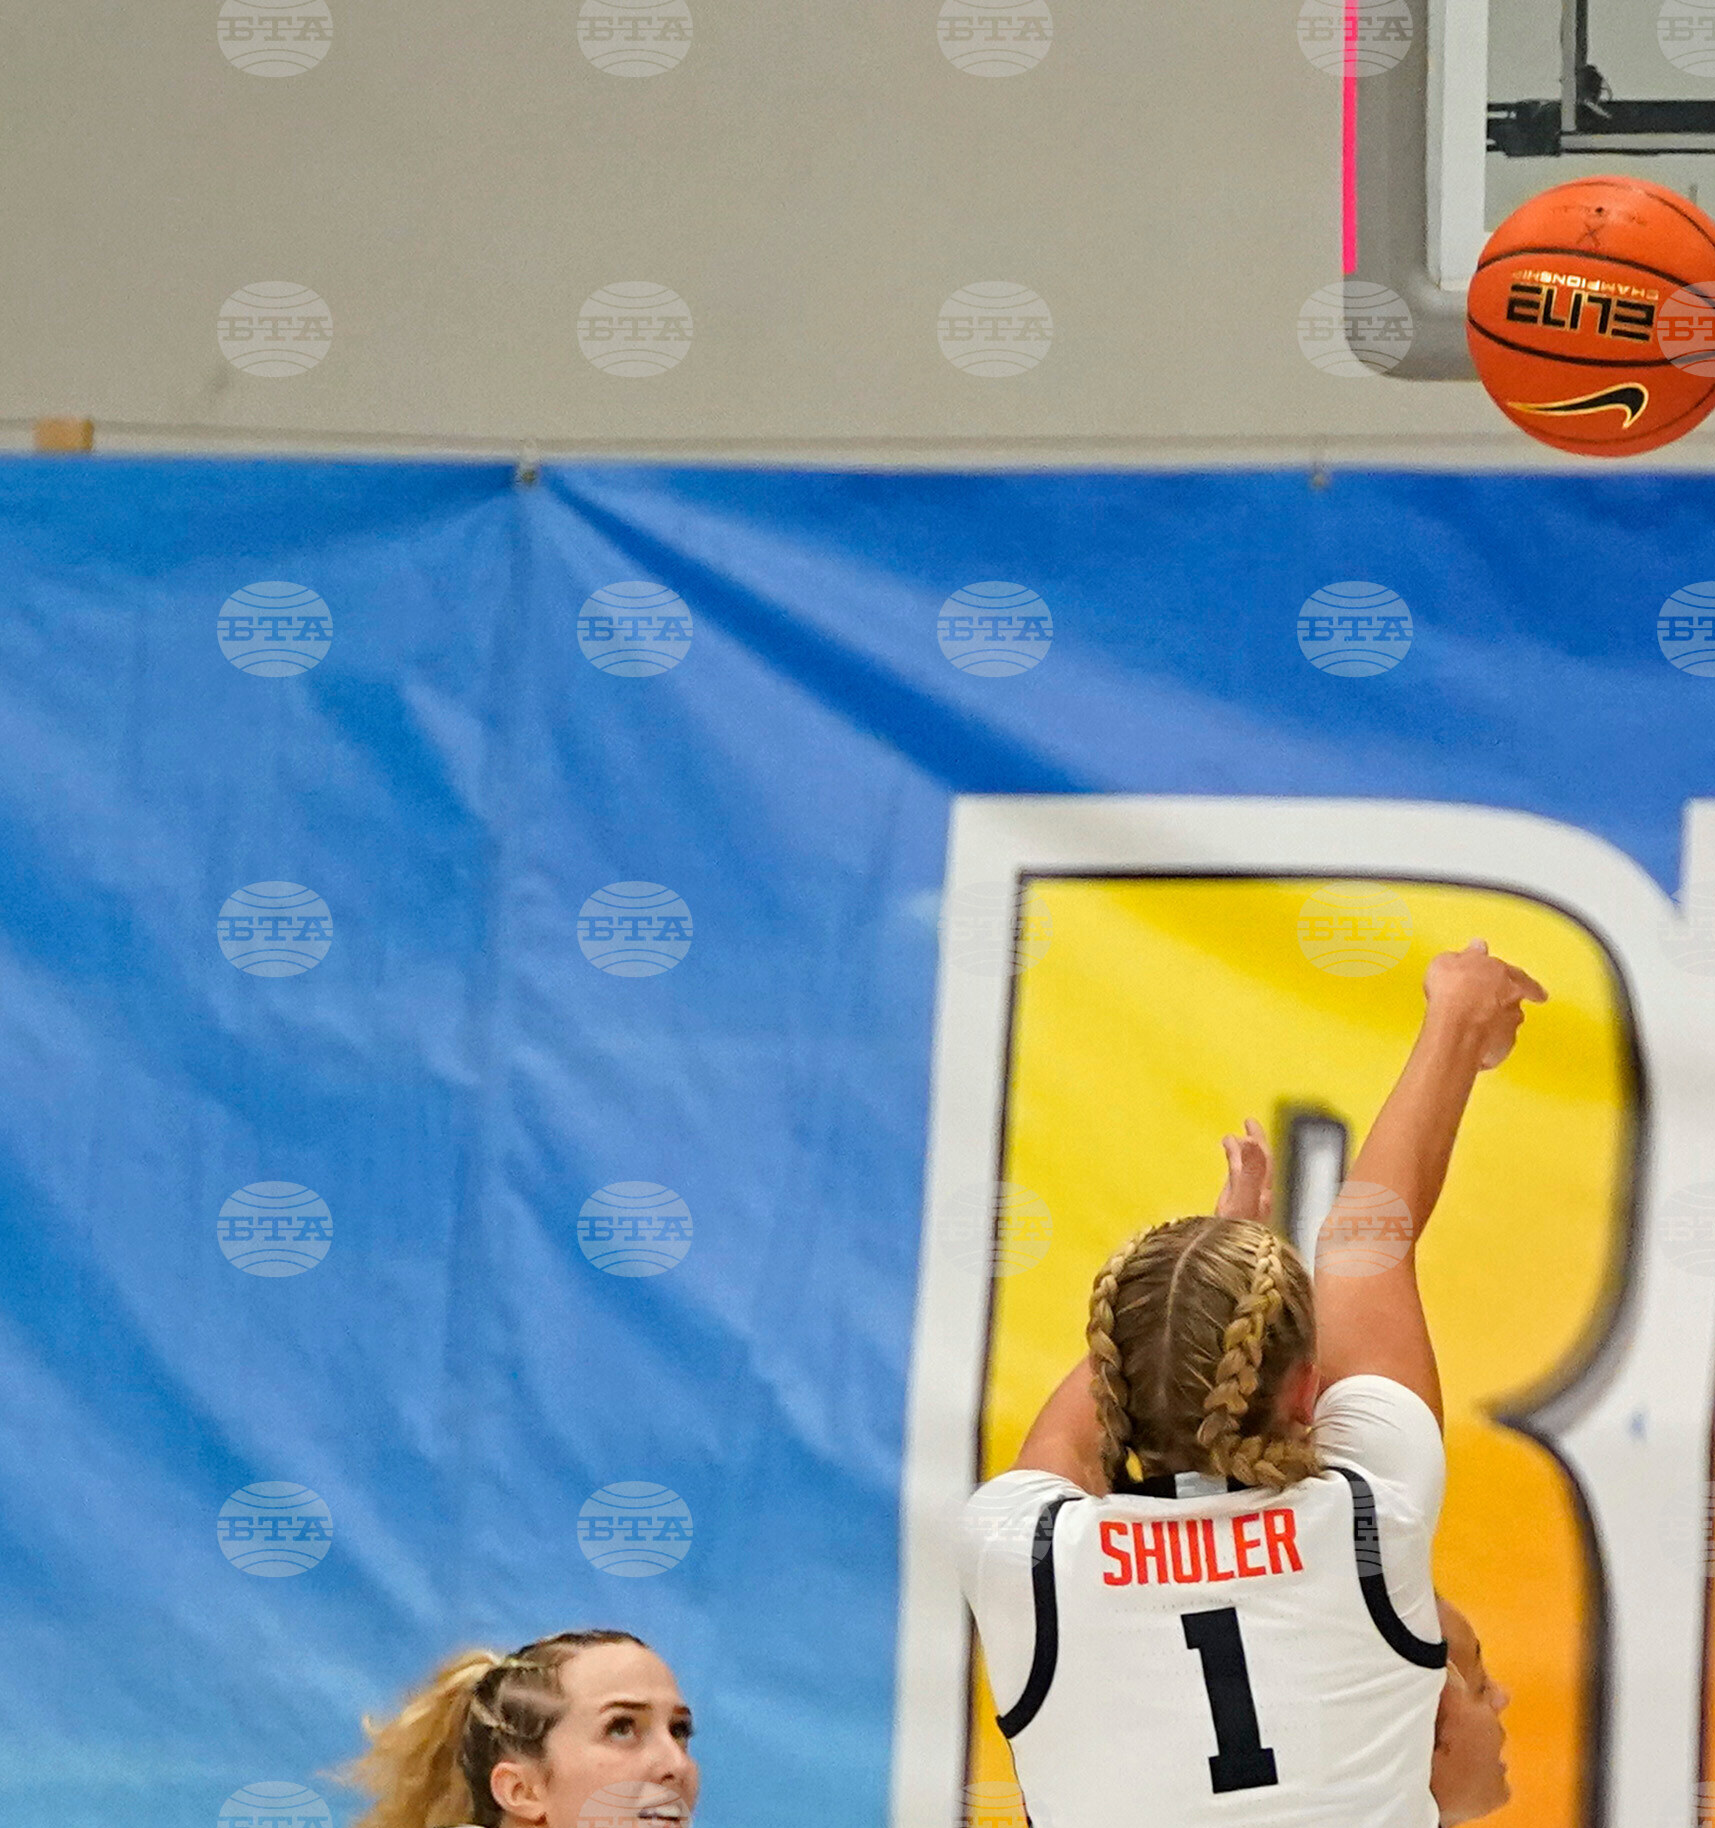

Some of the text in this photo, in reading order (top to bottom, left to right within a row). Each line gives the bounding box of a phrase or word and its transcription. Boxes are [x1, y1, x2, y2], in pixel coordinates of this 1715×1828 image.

[1506, 283, 1656, 342] ELITE
[1512, 269, 1660, 301] CHAMPIONSHIP
[1100, 1508, 1303, 1586] SHULER
[1180, 1606, 1278, 1794] 1
